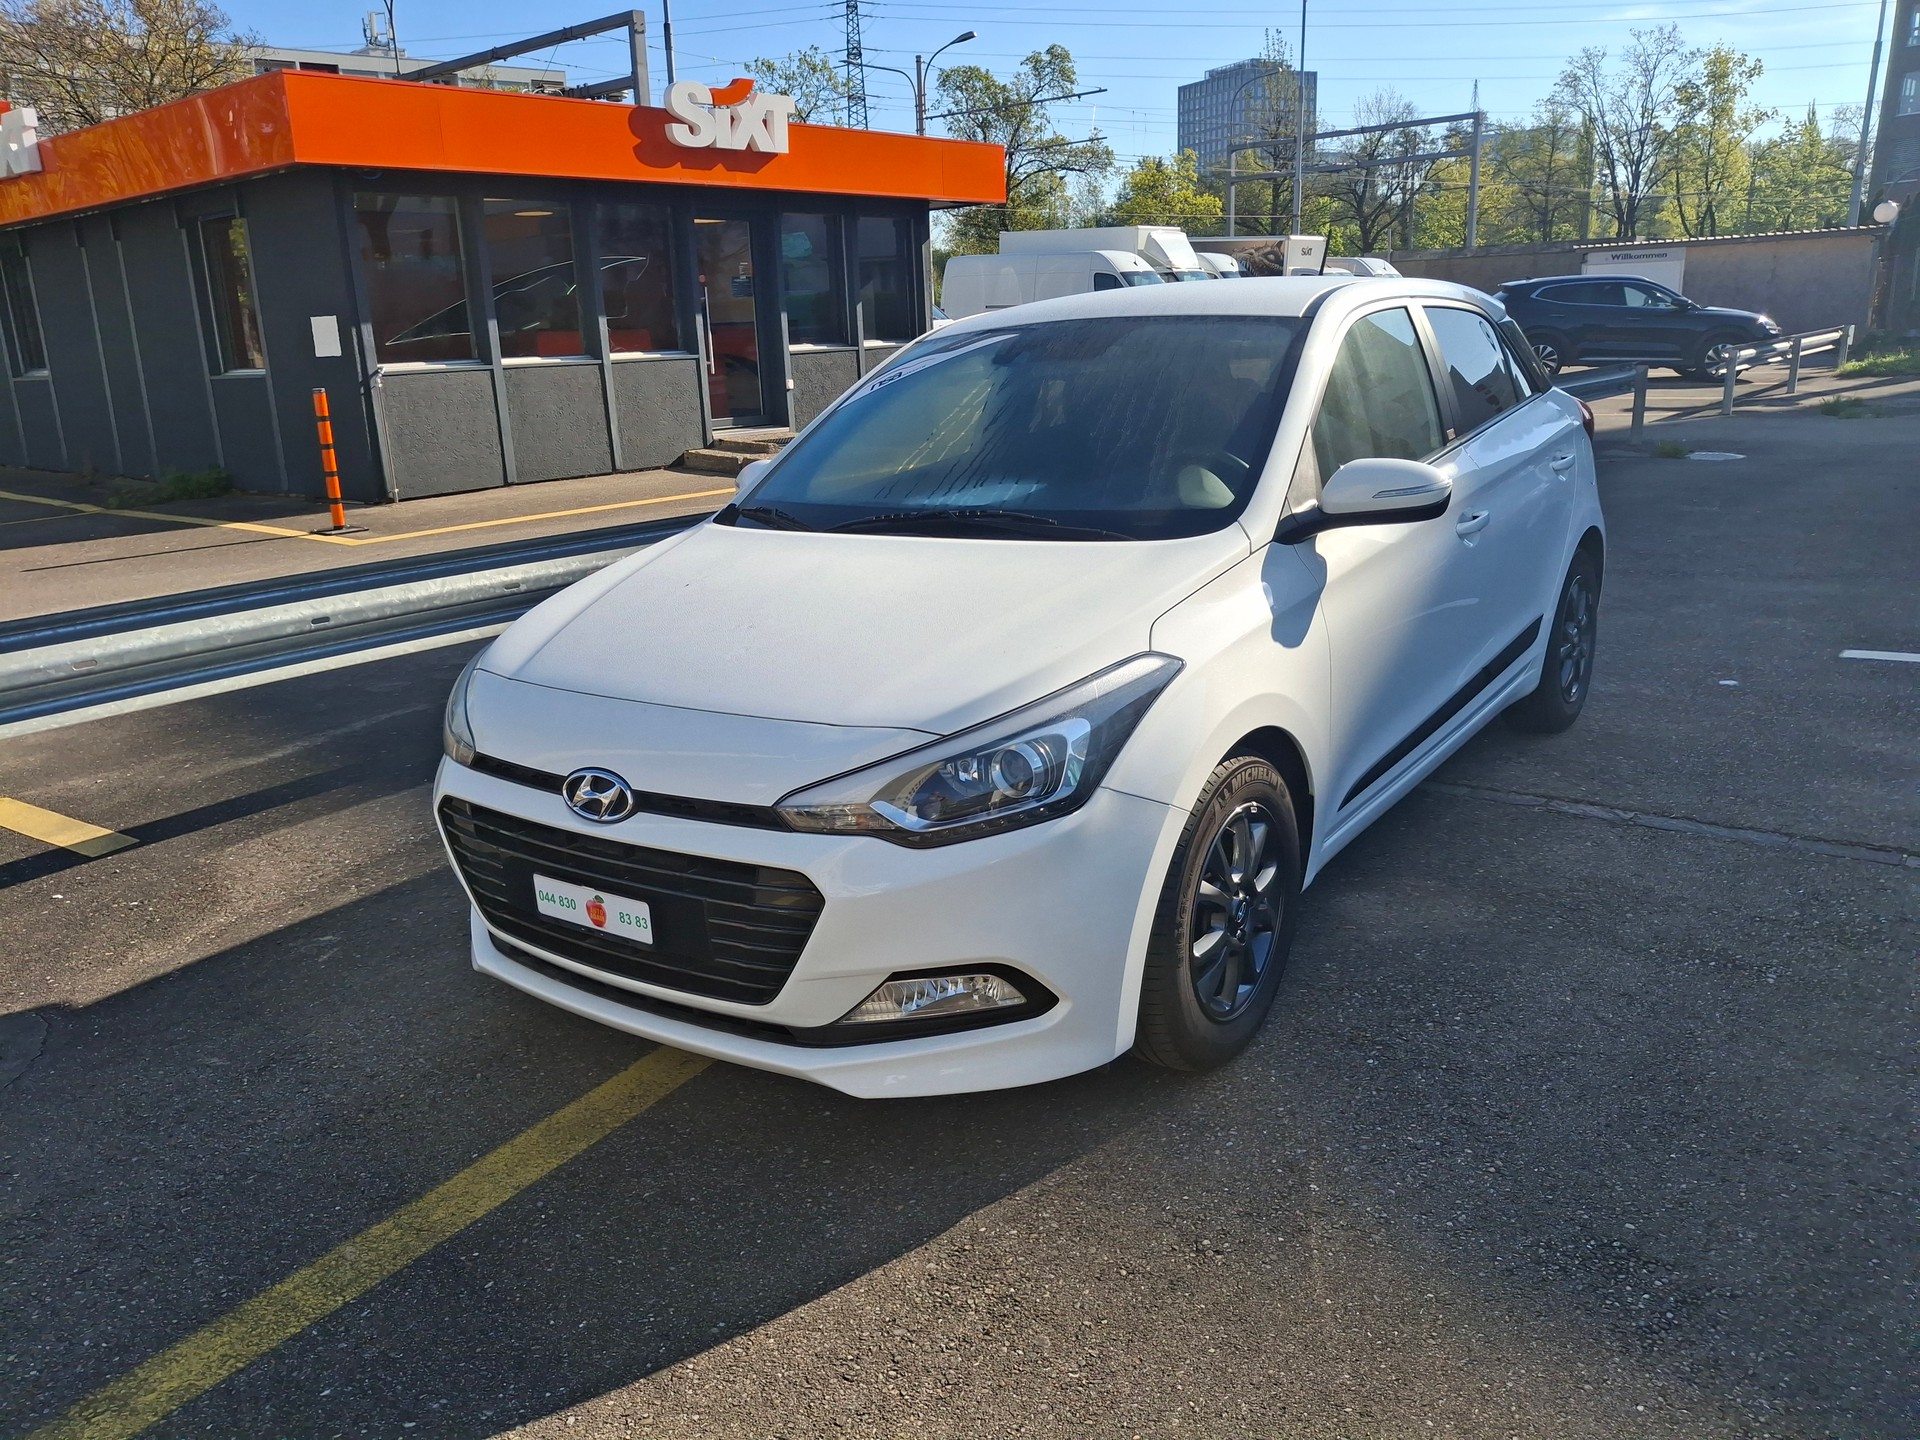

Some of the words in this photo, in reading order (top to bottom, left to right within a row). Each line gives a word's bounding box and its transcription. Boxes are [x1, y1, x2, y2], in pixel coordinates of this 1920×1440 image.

[1611, 252, 1668, 261] Willkommen
[1231, 766, 1280, 794] MICHELIN
[538, 890, 556, 904] 044
[558, 896, 577, 910] 830
[618, 912, 632, 925] 83
[635, 916, 648, 929] 83
